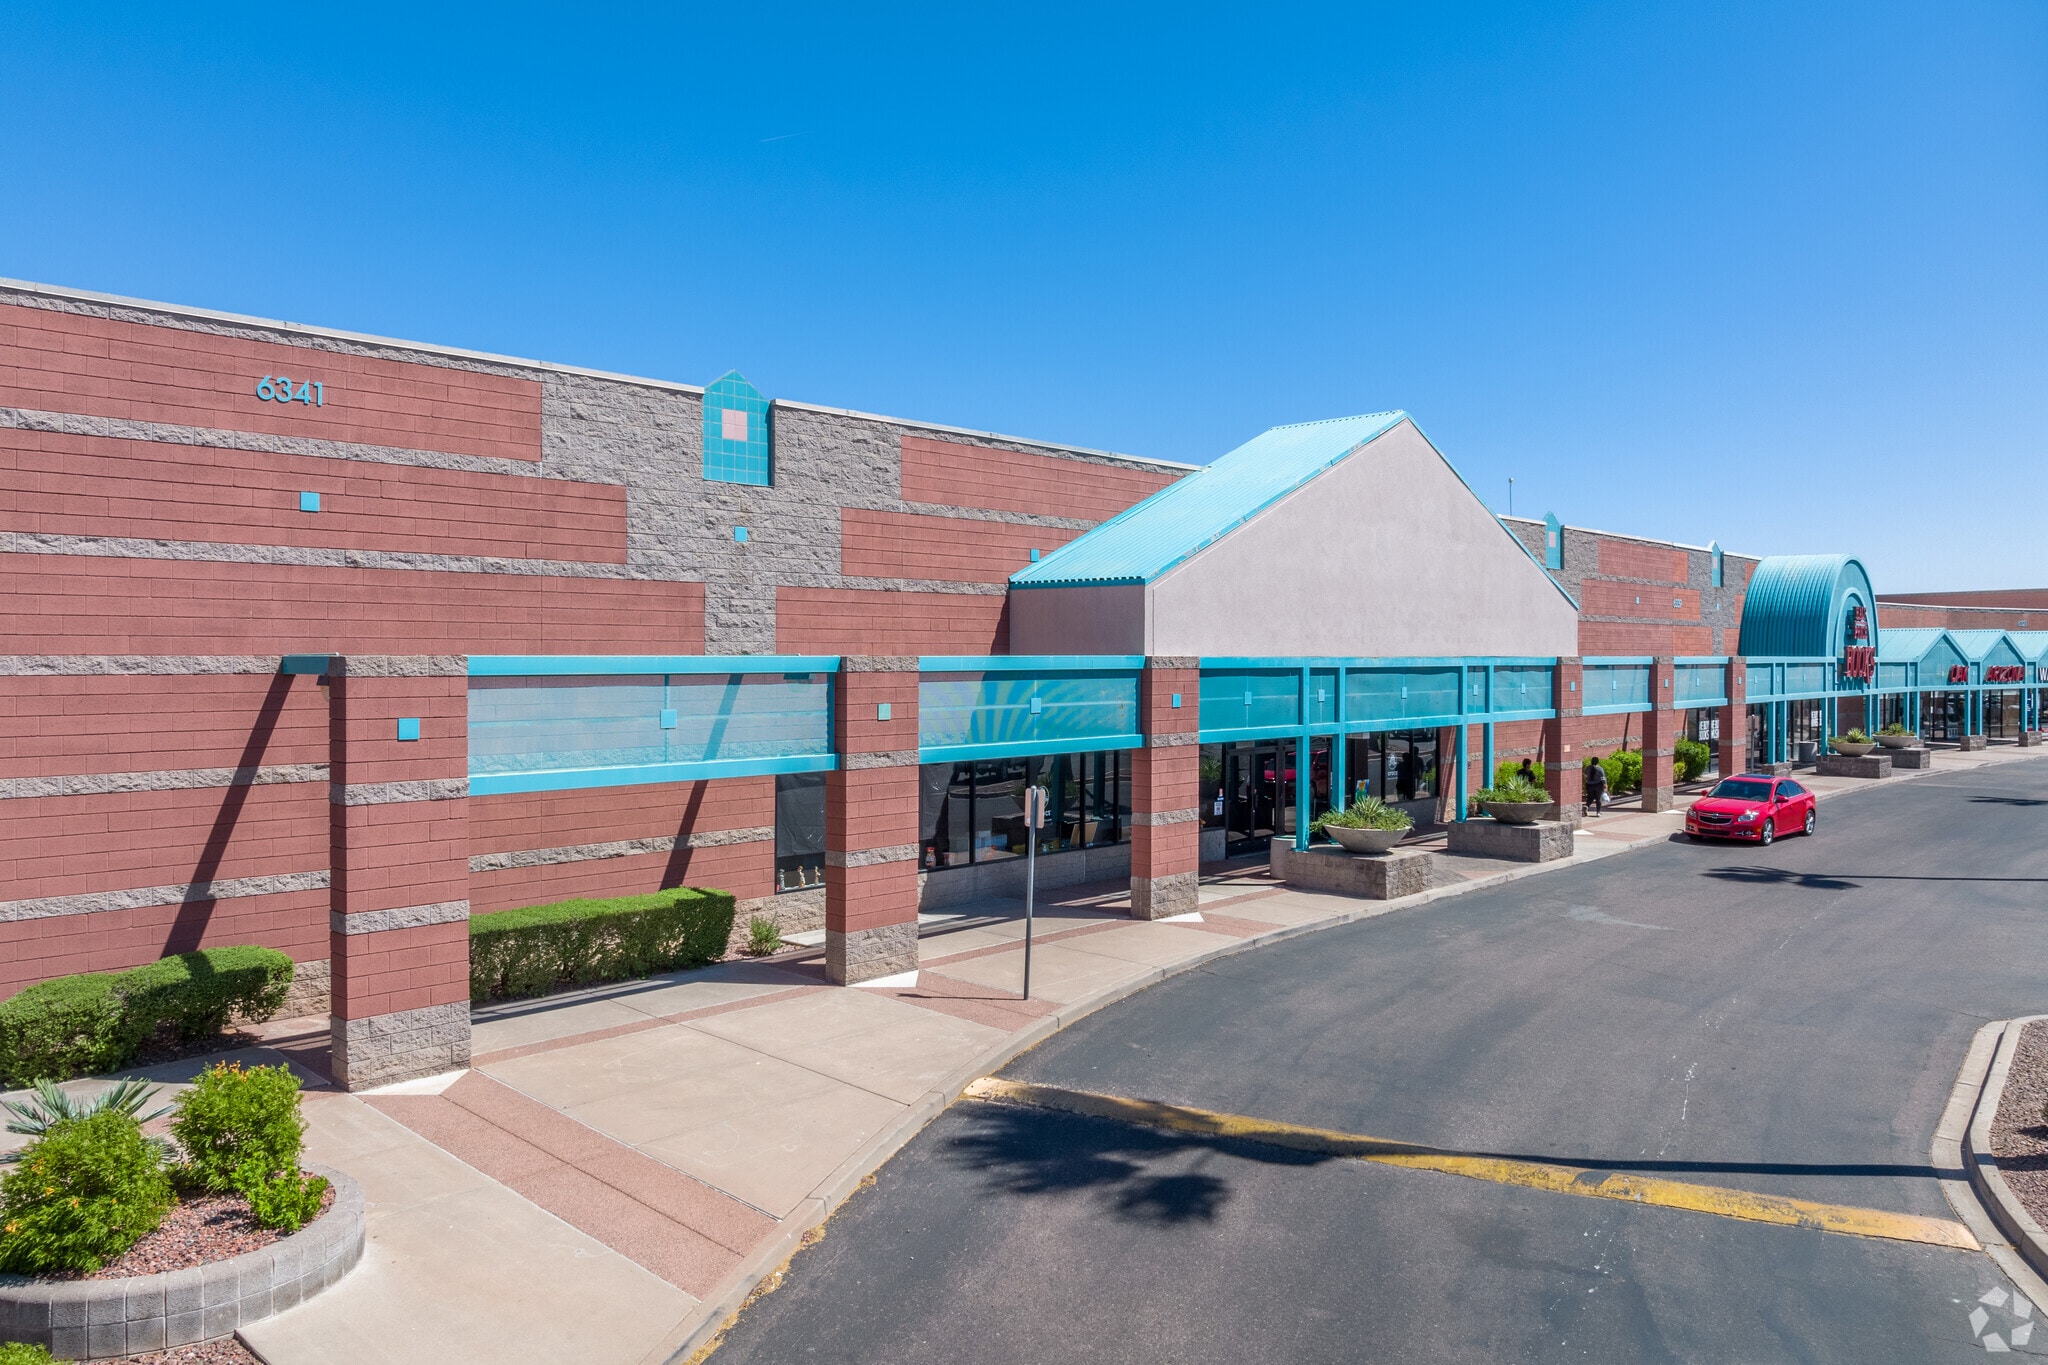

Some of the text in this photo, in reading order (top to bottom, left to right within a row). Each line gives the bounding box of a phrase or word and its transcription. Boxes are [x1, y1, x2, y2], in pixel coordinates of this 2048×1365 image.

[256, 375, 323, 407] 6341
[1847, 645, 1876, 684] BOOKS
[1985, 665, 2025, 683] ARIZONA
